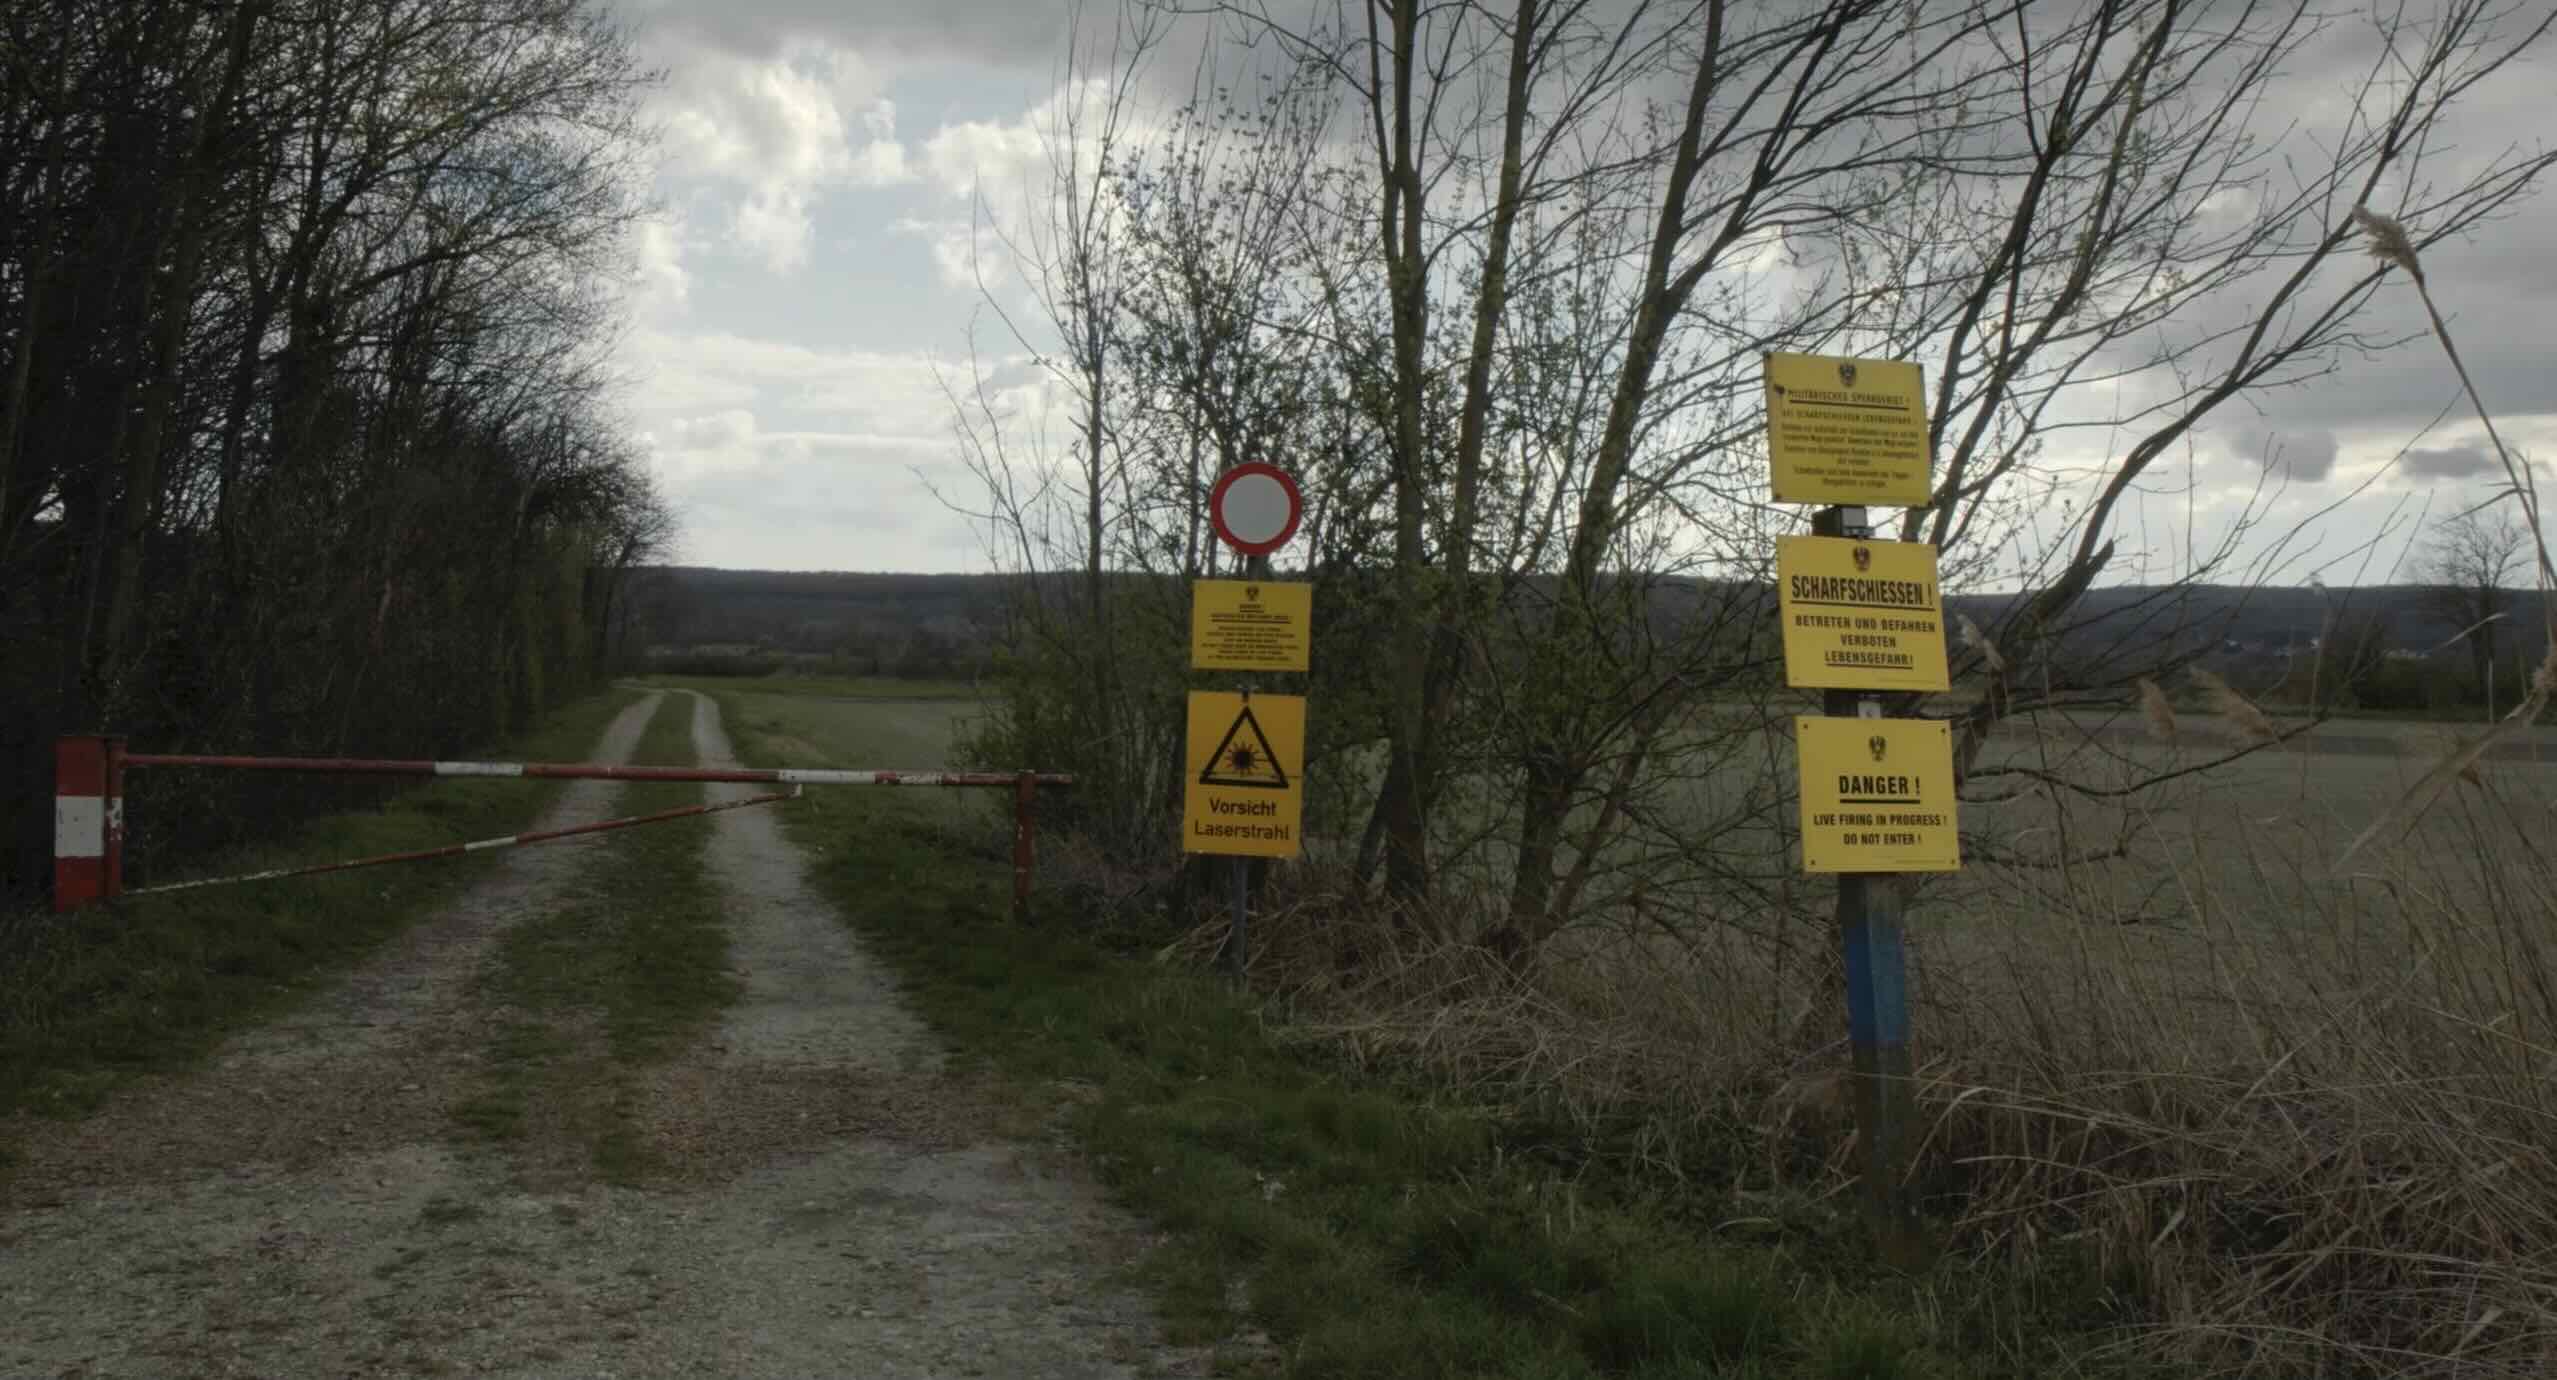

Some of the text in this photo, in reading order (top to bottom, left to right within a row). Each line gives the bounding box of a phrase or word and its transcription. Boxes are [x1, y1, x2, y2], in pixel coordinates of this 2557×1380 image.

[1792, 575, 1923, 605] SCHARFSCHIESSEN
[1796, 615, 1936, 632] BETRETEN UND BEFAHREN
[1841, 634, 1896, 648] VERBOTEN
[1839, 775, 1908, 795] DANGER
[1209, 796, 1277, 816] Vorsicht
[1814, 814, 1835, 826] LIVE
[1839, 814, 1873, 826] FIRING
[1876, 814, 1886, 826] IN
[1890, 814, 1941, 826] PROGRESS
[1194, 819, 1289, 840] Laserstrahl
[1843, 833, 1857, 845] DO
[1861, 834, 1880, 845] NOT
[1884, 834, 1915, 845] ENTER
